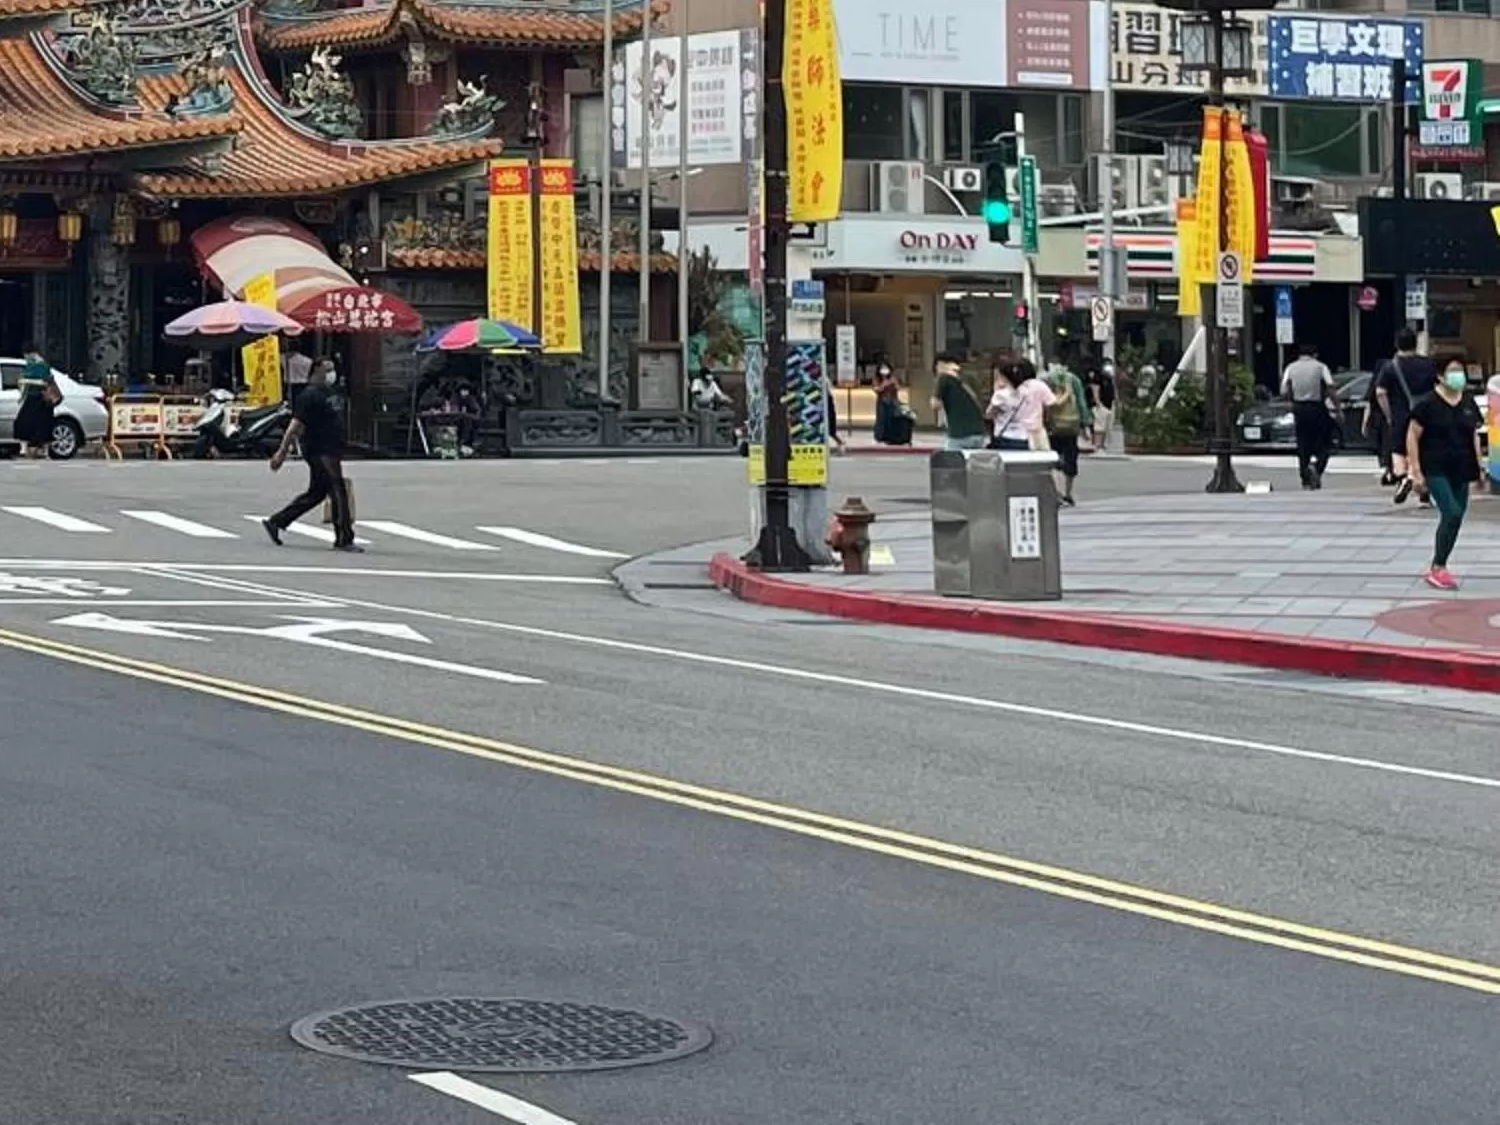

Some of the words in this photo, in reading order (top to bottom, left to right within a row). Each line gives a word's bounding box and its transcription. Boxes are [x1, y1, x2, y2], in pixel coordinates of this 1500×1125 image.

[878, 12, 960, 52] TIME
[1306, 61, 1392, 100] 補習班
[936, 233, 979, 251] DAY
